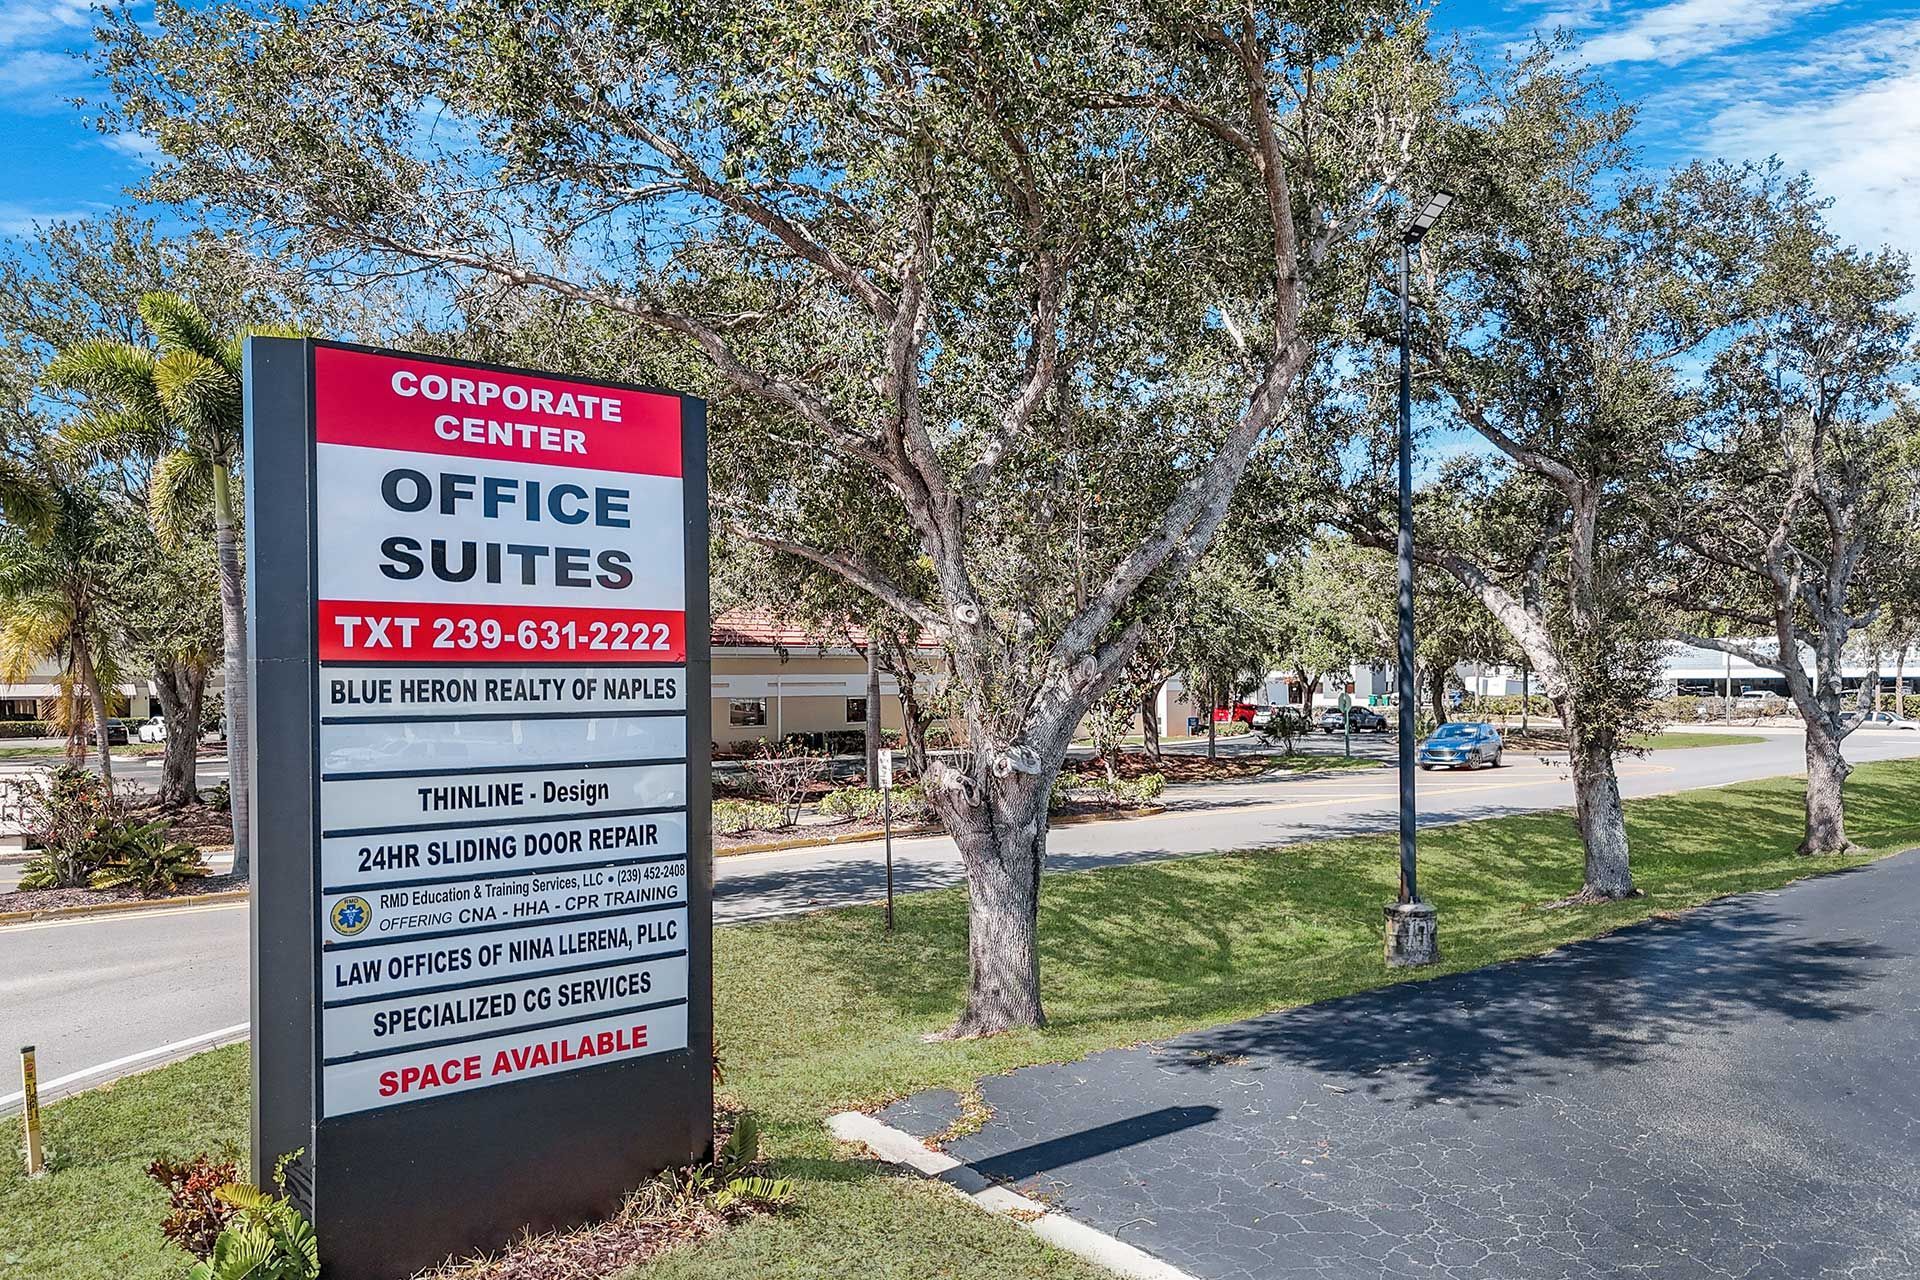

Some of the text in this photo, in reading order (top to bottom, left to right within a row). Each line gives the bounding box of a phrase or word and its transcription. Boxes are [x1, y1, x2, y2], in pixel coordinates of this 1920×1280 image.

[391, 371, 622, 423] CORPORATE
[435, 415, 587, 454] CENTER
[381, 468, 631, 529] OFFICE
[379, 537, 633, 590] SUITES
[335, 616, 670, 651] TXT 239-631-2222
[331, 678, 676, 704] BLUE HERON REALTY OF NAPLES
[418, 783, 524, 812] THINLINE
[543, 779, 609, 806] Design
[358, 824, 658, 872] 24HR SLIDING DOOR REPAIR
[379, 911, 453, 931] OFFERING
[458, 906, 497, 924] CNA
[513, 901, 549, 917] HHA
[565, 895, 599, 912] CPR
[604, 884, 679, 907] TRAINING
[380, 863, 686, 909] RMD Education & Training Services, LLC (239) 452-2408
[336, 919, 677, 987] LAW OFFICES OF NINA LLERENA, PLLC
[373, 971, 651, 1037] SPECIALIZED CG SERVICES
[378, 1025, 648, 1096] SPACE AVAILABLE
